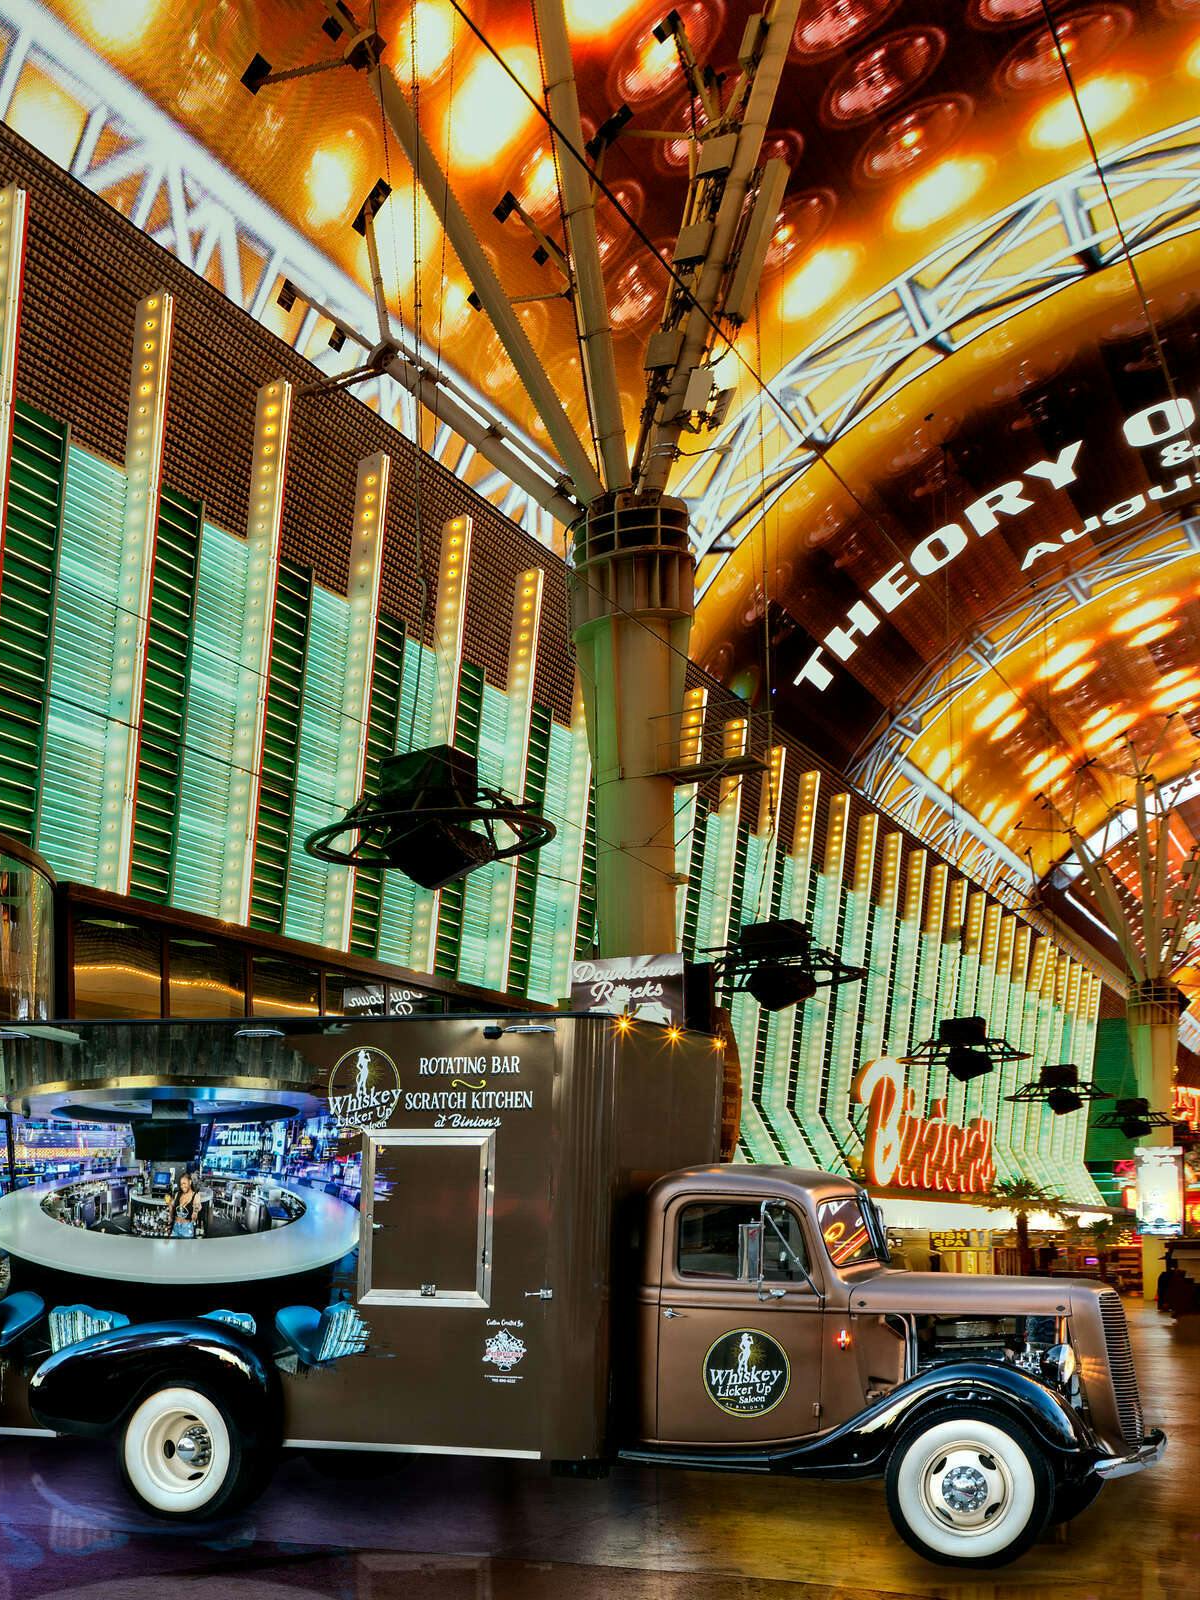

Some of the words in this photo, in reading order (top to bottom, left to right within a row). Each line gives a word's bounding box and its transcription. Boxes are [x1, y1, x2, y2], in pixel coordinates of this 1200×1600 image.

[1021, 472, 1200, 571] Augu
[793, 439, 1084, 692] THEORY
[1123, 398, 1196, 447] O
[419, 1056, 487, 1075] ROTATING
[491, 1055, 521, 1074] BAR
[328, 1086, 403, 1116] Whiskey
[405, 1091, 467, 1110] SCRATCH
[471, 1090, 534, 1109] KITCHEN
[336, 1109, 376, 1128] Licker
[376, 1104, 393, 1122] Up
[434, 1113, 447, 1128] at
[449, 1113, 502, 1128] Binion's
[933, 1239, 966, 1247] SPA
[709, 1365, 784, 1386] Whiskey
[717, 1384, 753, 1397] Licker
[756, 1382, 772, 1395] Up
[739, 1395, 766, 1404] Saloon
